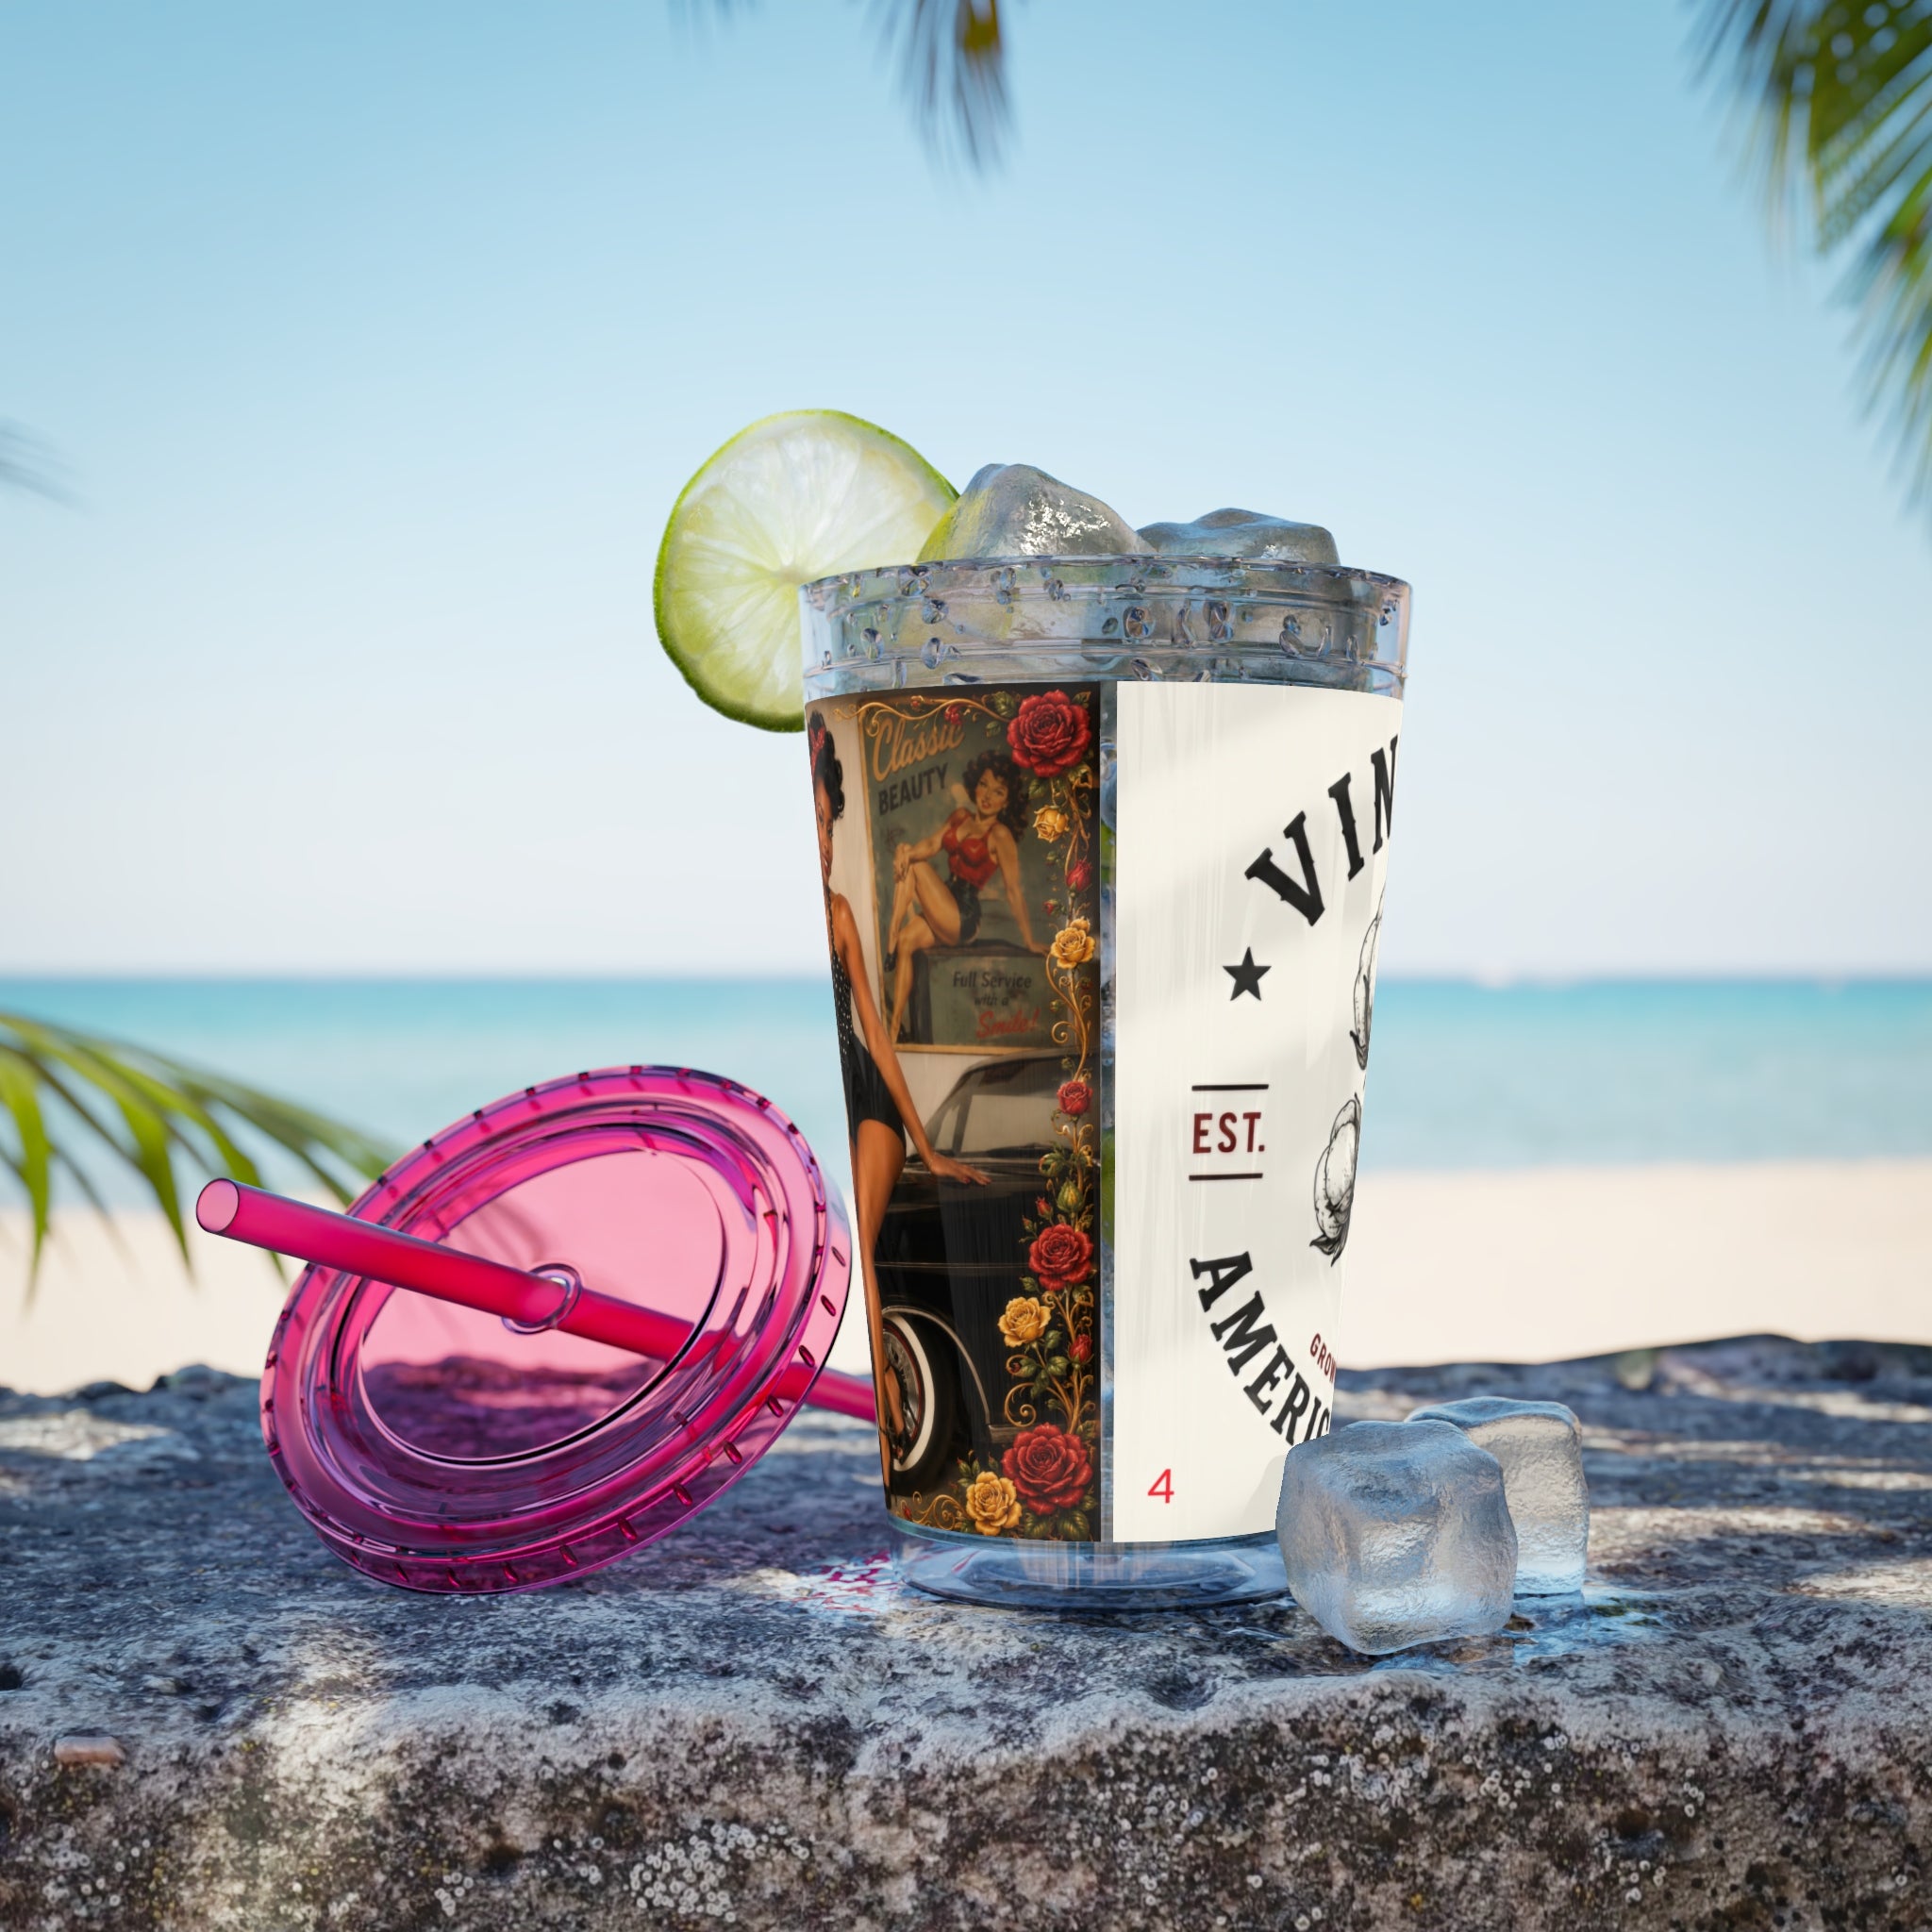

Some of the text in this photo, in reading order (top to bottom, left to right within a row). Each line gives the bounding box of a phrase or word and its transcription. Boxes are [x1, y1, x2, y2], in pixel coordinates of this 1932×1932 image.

[872, 717, 965, 782] Classic
[877, 762, 948, 816] BEAUTY
[1244, 734, 1398, 926] VIN
[952, 971, 1032, 989] Full Service
[976, 1007, 1041, 1040] Smile!
[1192, 1111, 1265, 1154] EST.
[1147, 1469, 1174, 1504] 4
